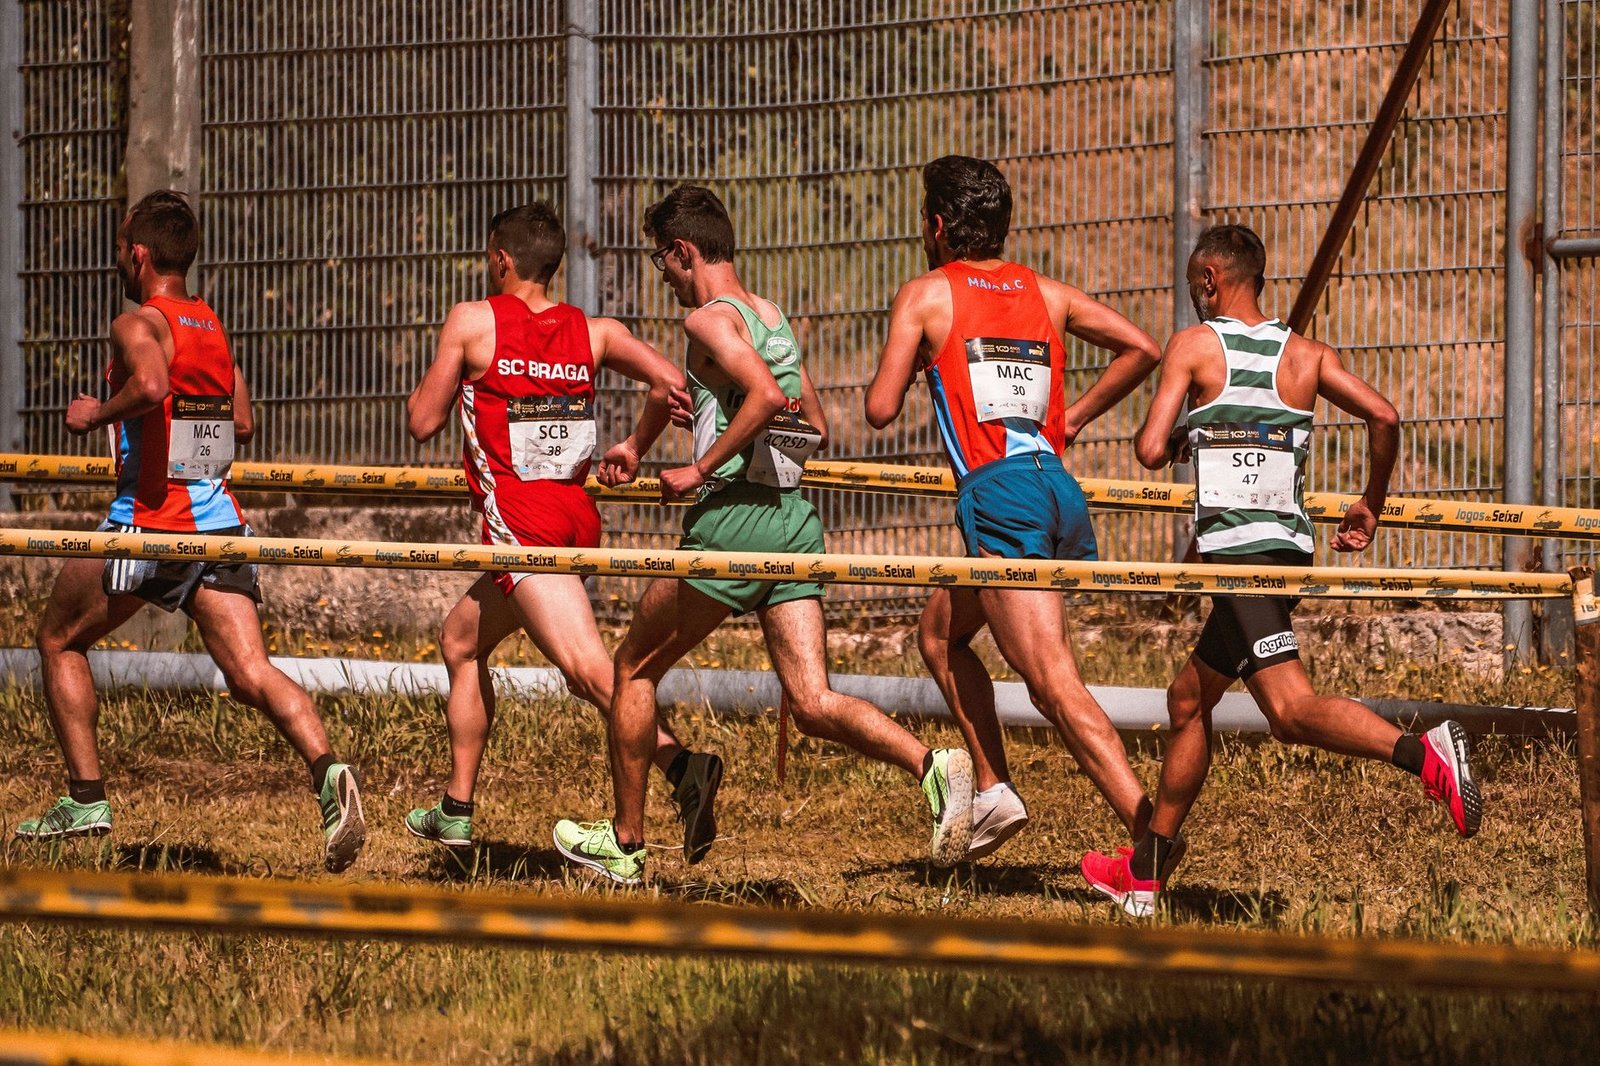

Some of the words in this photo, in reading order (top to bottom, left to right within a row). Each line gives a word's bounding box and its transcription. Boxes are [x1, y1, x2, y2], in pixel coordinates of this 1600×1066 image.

[497, 359, 525, 375] SC
[528, 360, 589, 382] BRAGA
[997, 365, 1033, 381] MAC
[1012, 385, 1025, 396] 30
[193, 424, 220, 439] MAC
[539, 425, 568, 439] SCB
[764, 433, 807, 448] ACRSD
[200, 445, 210, 456] 26
[548, 446, 561, 456] 38
[0, 460, 17, 473] eixal
[1232, 452, 1266, 467] SCP
[86, 464, 110, 476] Seixal
[270, 470, 294, 482] Seixal
[362, 472, 386, 484] Seixal
[914, 472, 943, 485] Seixal
[1242, 474, 1258, 485] 47
[638, 481, 660, 491] Seixa
[1106, 486, 1134, 500] Jogos
[1141, 488, 1171, 501] Seixal
[1380, 503, 1404, 516] eixal
[1456, 508, 1485, 523] Jogos
[1492, 510, 1523, 523] Seixal
[27, 537, 55, 550] Jogos
[61, 538, 91, 552] Seixal
[142, 541, 170, 555] Jogos
[176, 542, 207, 556] Seixal
[259, 545, 287, 559] Jogos
[293, 545, 323, 560] Seixal
[409, 550, 440, 564] Seixal
[491, 553, 520, 568] Jogos
[527, 553, 557, 568] Seixal
[610, 556, 638, 570] Jogos
[644, 557, 675, 571] Seixal
[728, 560, 758, 574] Jogos
[764, 561, 795, 575] Seixal
[848, 564, 878, 580] Jogos
[884, 564, 916, 578] Seixal
[970, 566, 1000, 582] Jogos
[1006, 567, 1037, 582] Seixal
[1091, 571, 1123, 587] Jogos
[1129, 571, 1161, 586] Seixal
[1253, 575, 1286, 589] Seixal
[1381, 578, 1413, 592] Seixal
[1508, 582, 1542, 594] Seixal
[1260, 634, 1297, 654] Agriloj
